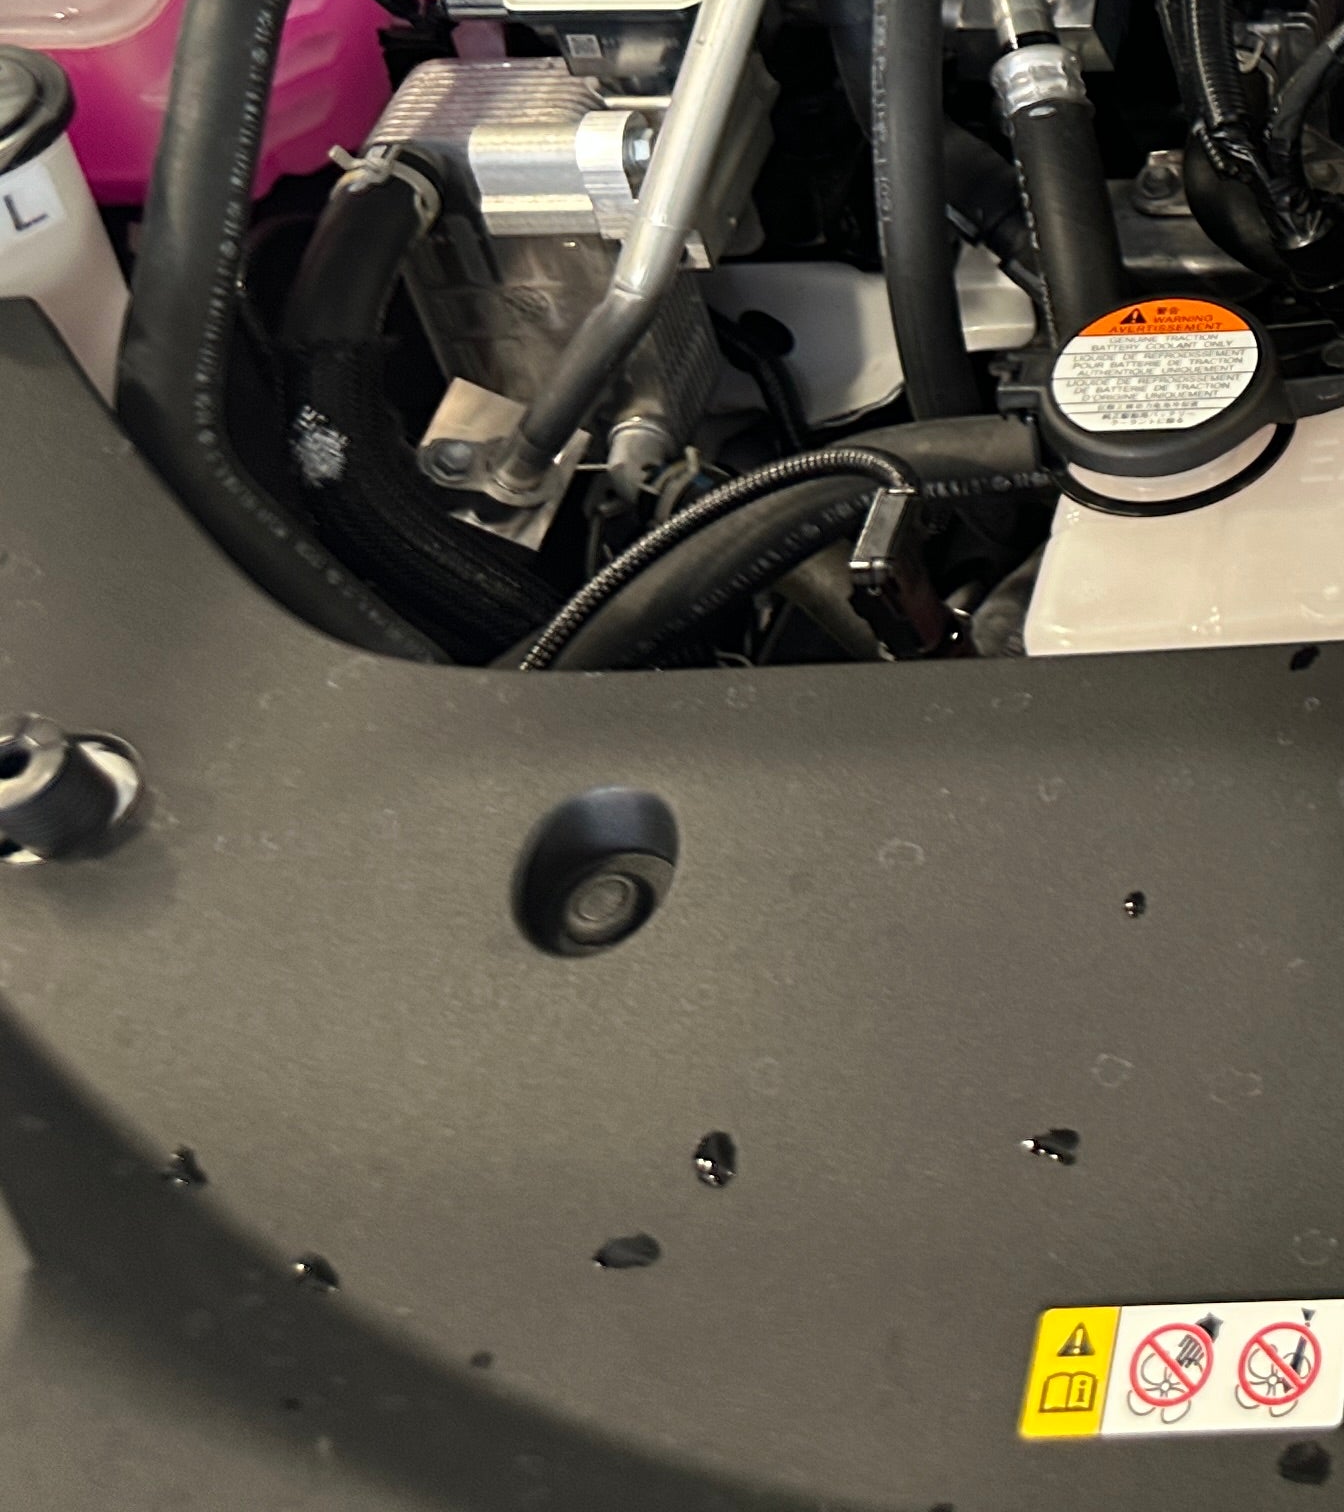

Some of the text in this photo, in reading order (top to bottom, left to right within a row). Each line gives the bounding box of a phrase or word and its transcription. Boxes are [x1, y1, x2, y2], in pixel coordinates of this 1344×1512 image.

[4, 194, 49, 232] L
[1154, 314, 1213, 324] WARNING
[1109, 322, 1223, 333] AVERTISSEMENT
[1110, 334, 1218, 344] GENUINE TRACTION
[1091, 343, 1139, 352] BATTERY
[1145, 342, 1197, 350] COOLANT
[1073, 354, 1116, 362] LIQUIDE
[1144, 350, 1245, 359] REFROIDISSEMENT
[1073, 361, 1104, 369] POUR
[1190, 357, 1243, 365] TRACTION
[1077, 366, 1235, 376] AUTHENTIQUE UNIQUEMENT
[1066, 379, 1110, 387] LIQUIDE
[1138, 374, 1241, 384] REFROIDISSEMENT
[1096, 385, 1147, 393] BATTERIE
[1176, 382, 1230, 390] TRACTION
[1082, 390, 1218, 402] D'ORIGINE UNIQUEMENT
